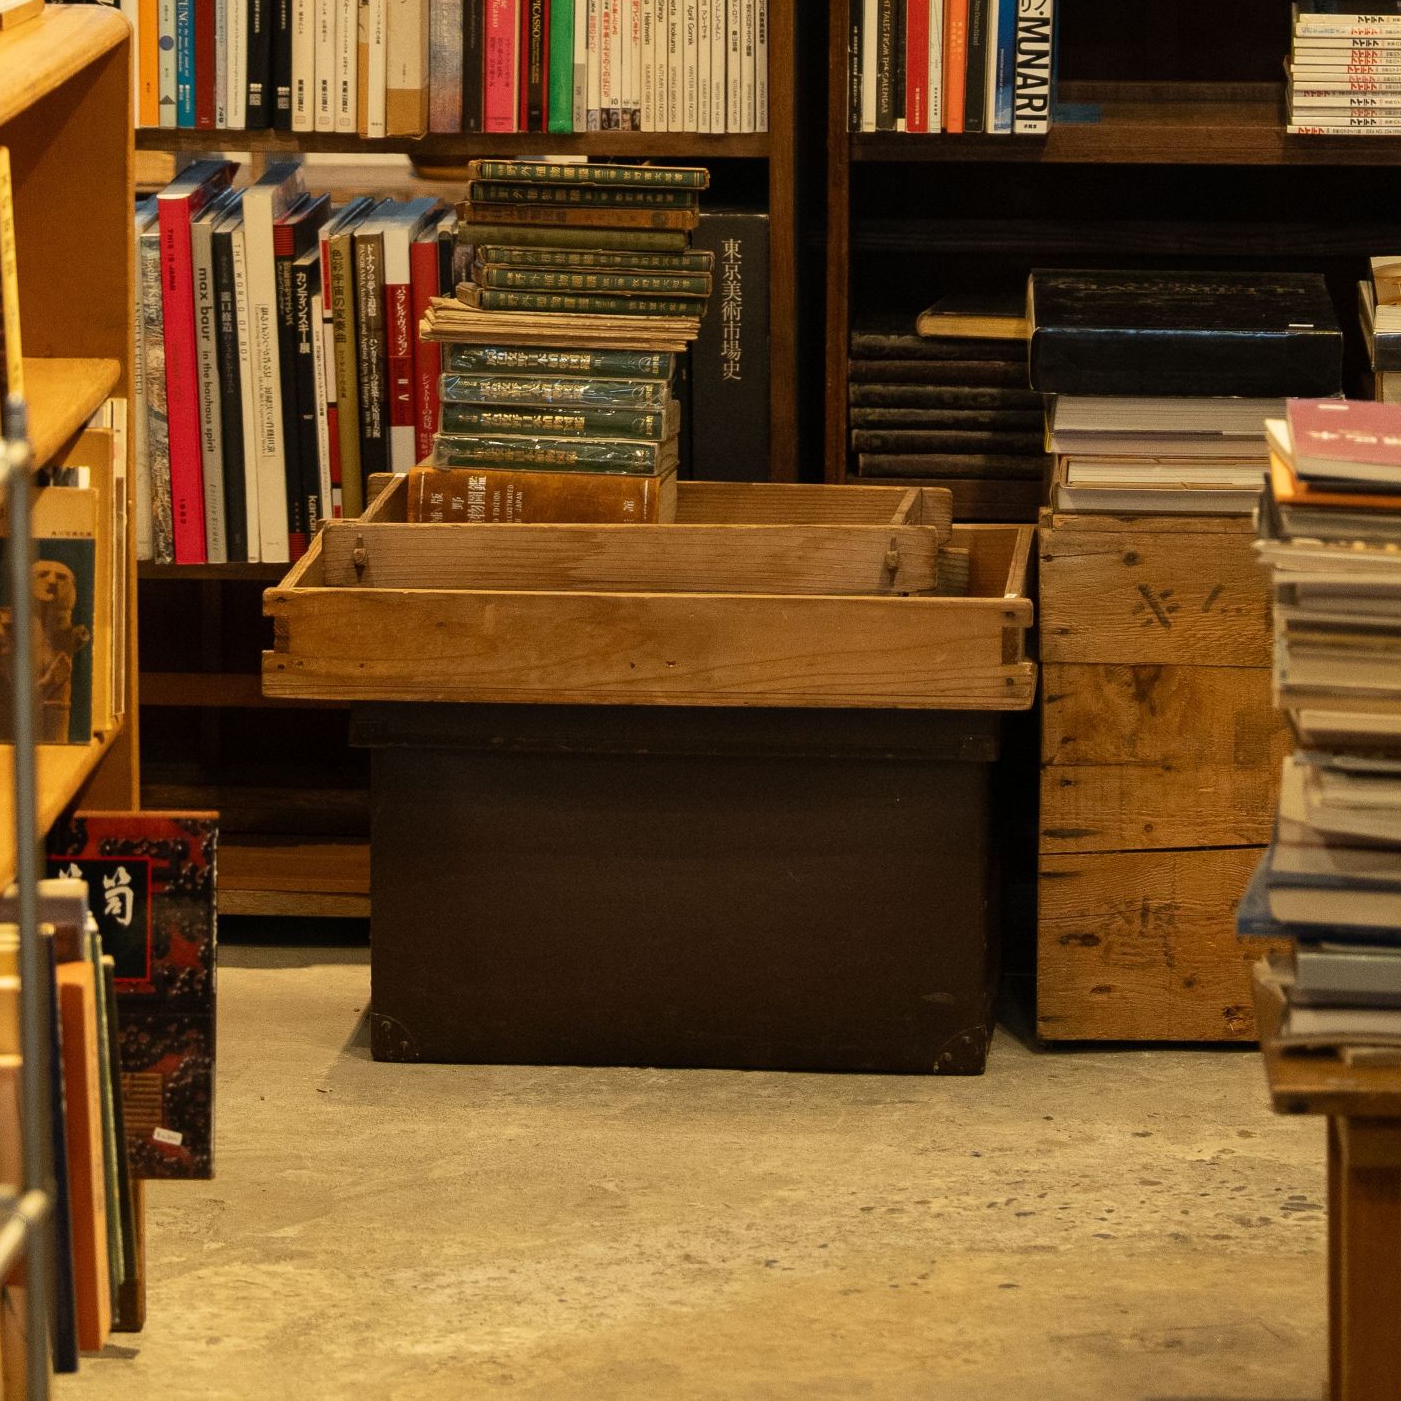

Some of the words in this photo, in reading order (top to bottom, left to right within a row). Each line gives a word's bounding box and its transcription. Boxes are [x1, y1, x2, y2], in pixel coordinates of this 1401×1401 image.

[881, 10, 891, 32] TALES
[669, 21, 677, 54] Inokuma
[881, 33, 890, 56] FROM
[1016, 17, 1053, 120] MUNARI
[880, 72, 890, 115] CALENDAR
[166, 228, 175, 249] THIS
[233, 243, 241, 265] THE
[168, 265, 177, 291] JAPAN
[198, 267, 211, 301] max
[364, 242, 377, 317] ドナウの夢と追憶
[235, 272, 244, 314] WORLD
[199, 305, 214, 341] baur
[295, 271, 311, 354] カンディンスキー展
[720, 238, 744, 382] 東京美術市場史
[238, 320, 246, 333] OF
[202, 350, 212, 360] in
[240, 340, 248, 363] BOX
[202, 362, 213, 379] the
[202, 381, 215, 425] bauhaus
[203, 427, 216, 453] spirit
[492, 490, 500, 516] EDITION
[515, 491, 523, 512] JAPAN
